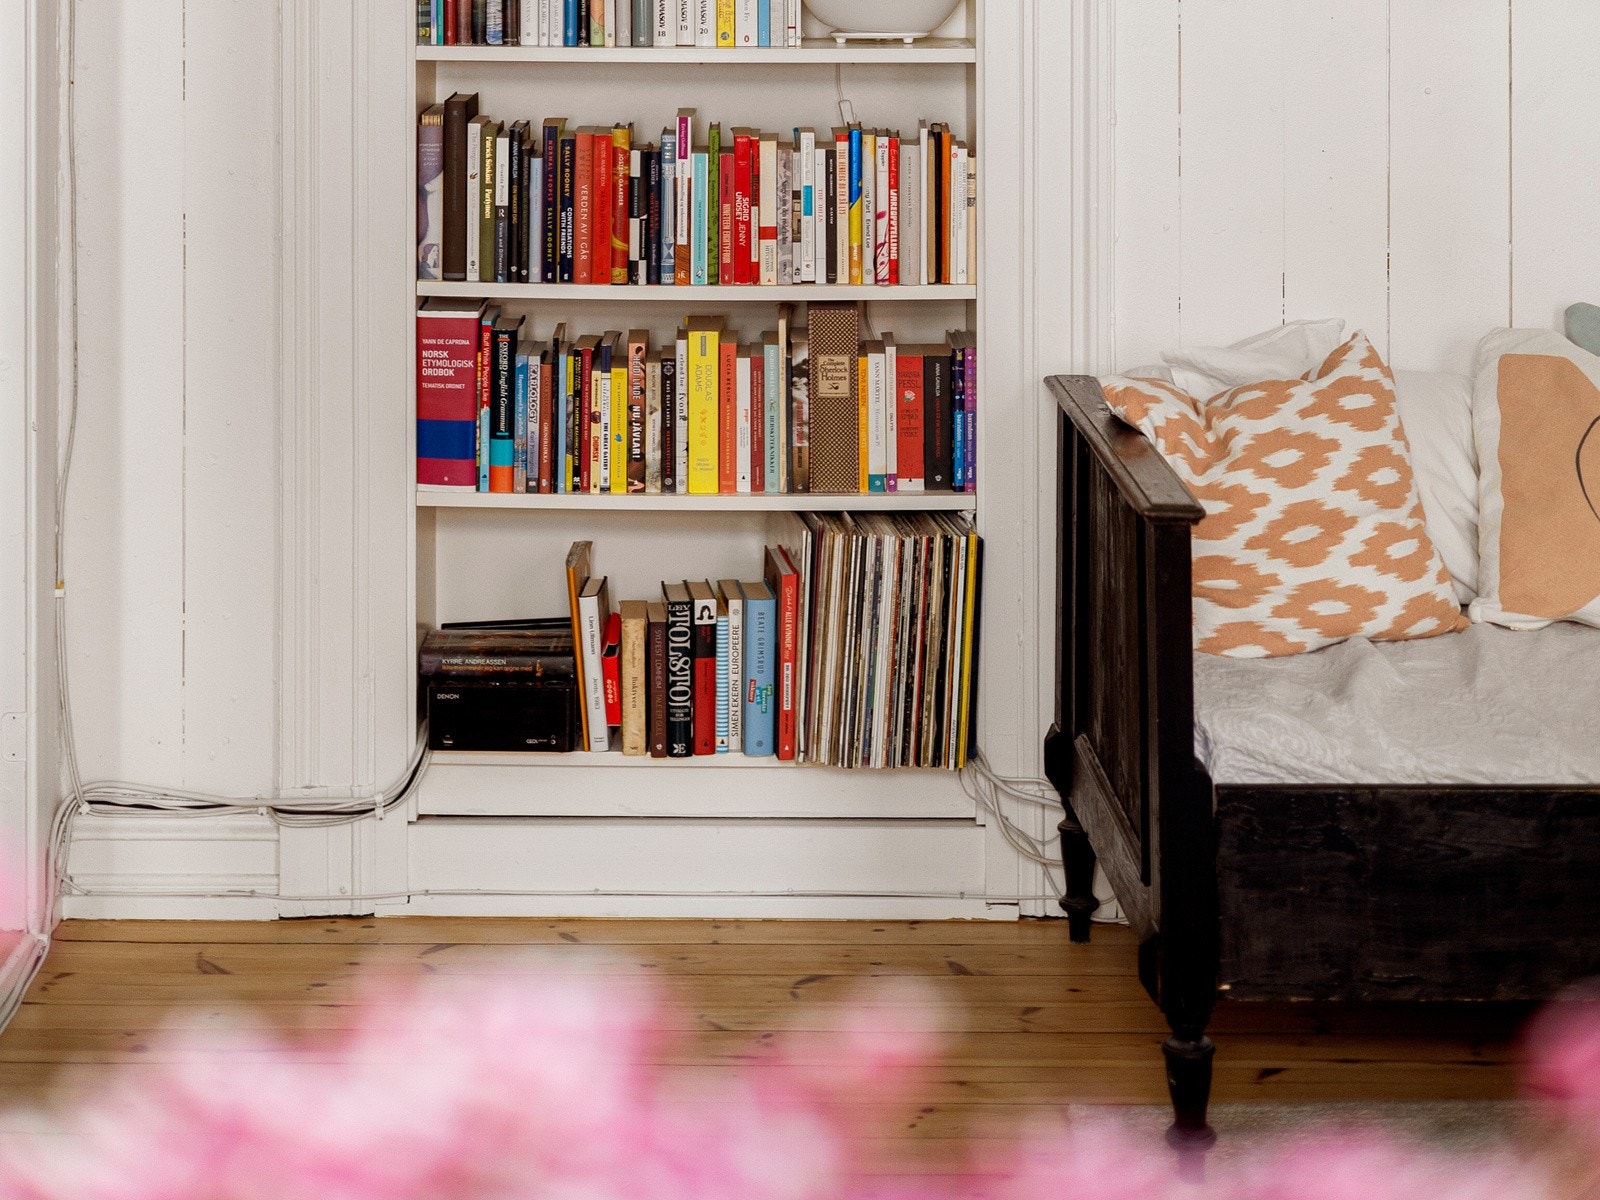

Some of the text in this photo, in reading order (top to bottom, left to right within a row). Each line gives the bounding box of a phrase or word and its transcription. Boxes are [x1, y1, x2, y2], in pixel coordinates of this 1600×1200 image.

[742, 12, 750, 22] Fry
[735, 192, 743, 221] UNDSET
[581, 223, 587, 233] AV
[722, 203, 731, 263] NINETEEN EIGHTY-FOUR
[889, 189, 897, 259] VAREOPPTELLING
[580, 242, 588, 260] GÅR
[422, 350, 449, 358] NORSK
[422, 359, 474, 368] ETYMOLOGISK
[422, 368, 455, 376] ORDBOK
[500, 371, 508, 397] English
[632, 355, 642, 400] HEIDI LINDE
[705, 364, 713, 401] DOUGLAS
[821, 372, 847, 381] Holmes
[528, 364, 539, 424] KARLOLOGY
[499, 398, 508, 432] Grammar
[631, 405, 644, 458] NU, JÄVLAR!
[592, 436, 600, 463] CHOMSKY
[757, 612, 765, 634] BEATE
[785, 611, 793, 648] ALLE KVINNER
[655, 629, 663, 657] SYLFEST
[668, 610, 691, 708] TOLSTOJ
[731, 679, 739, 709] EKERN
[731, 710, 739, 737] SIMEN
